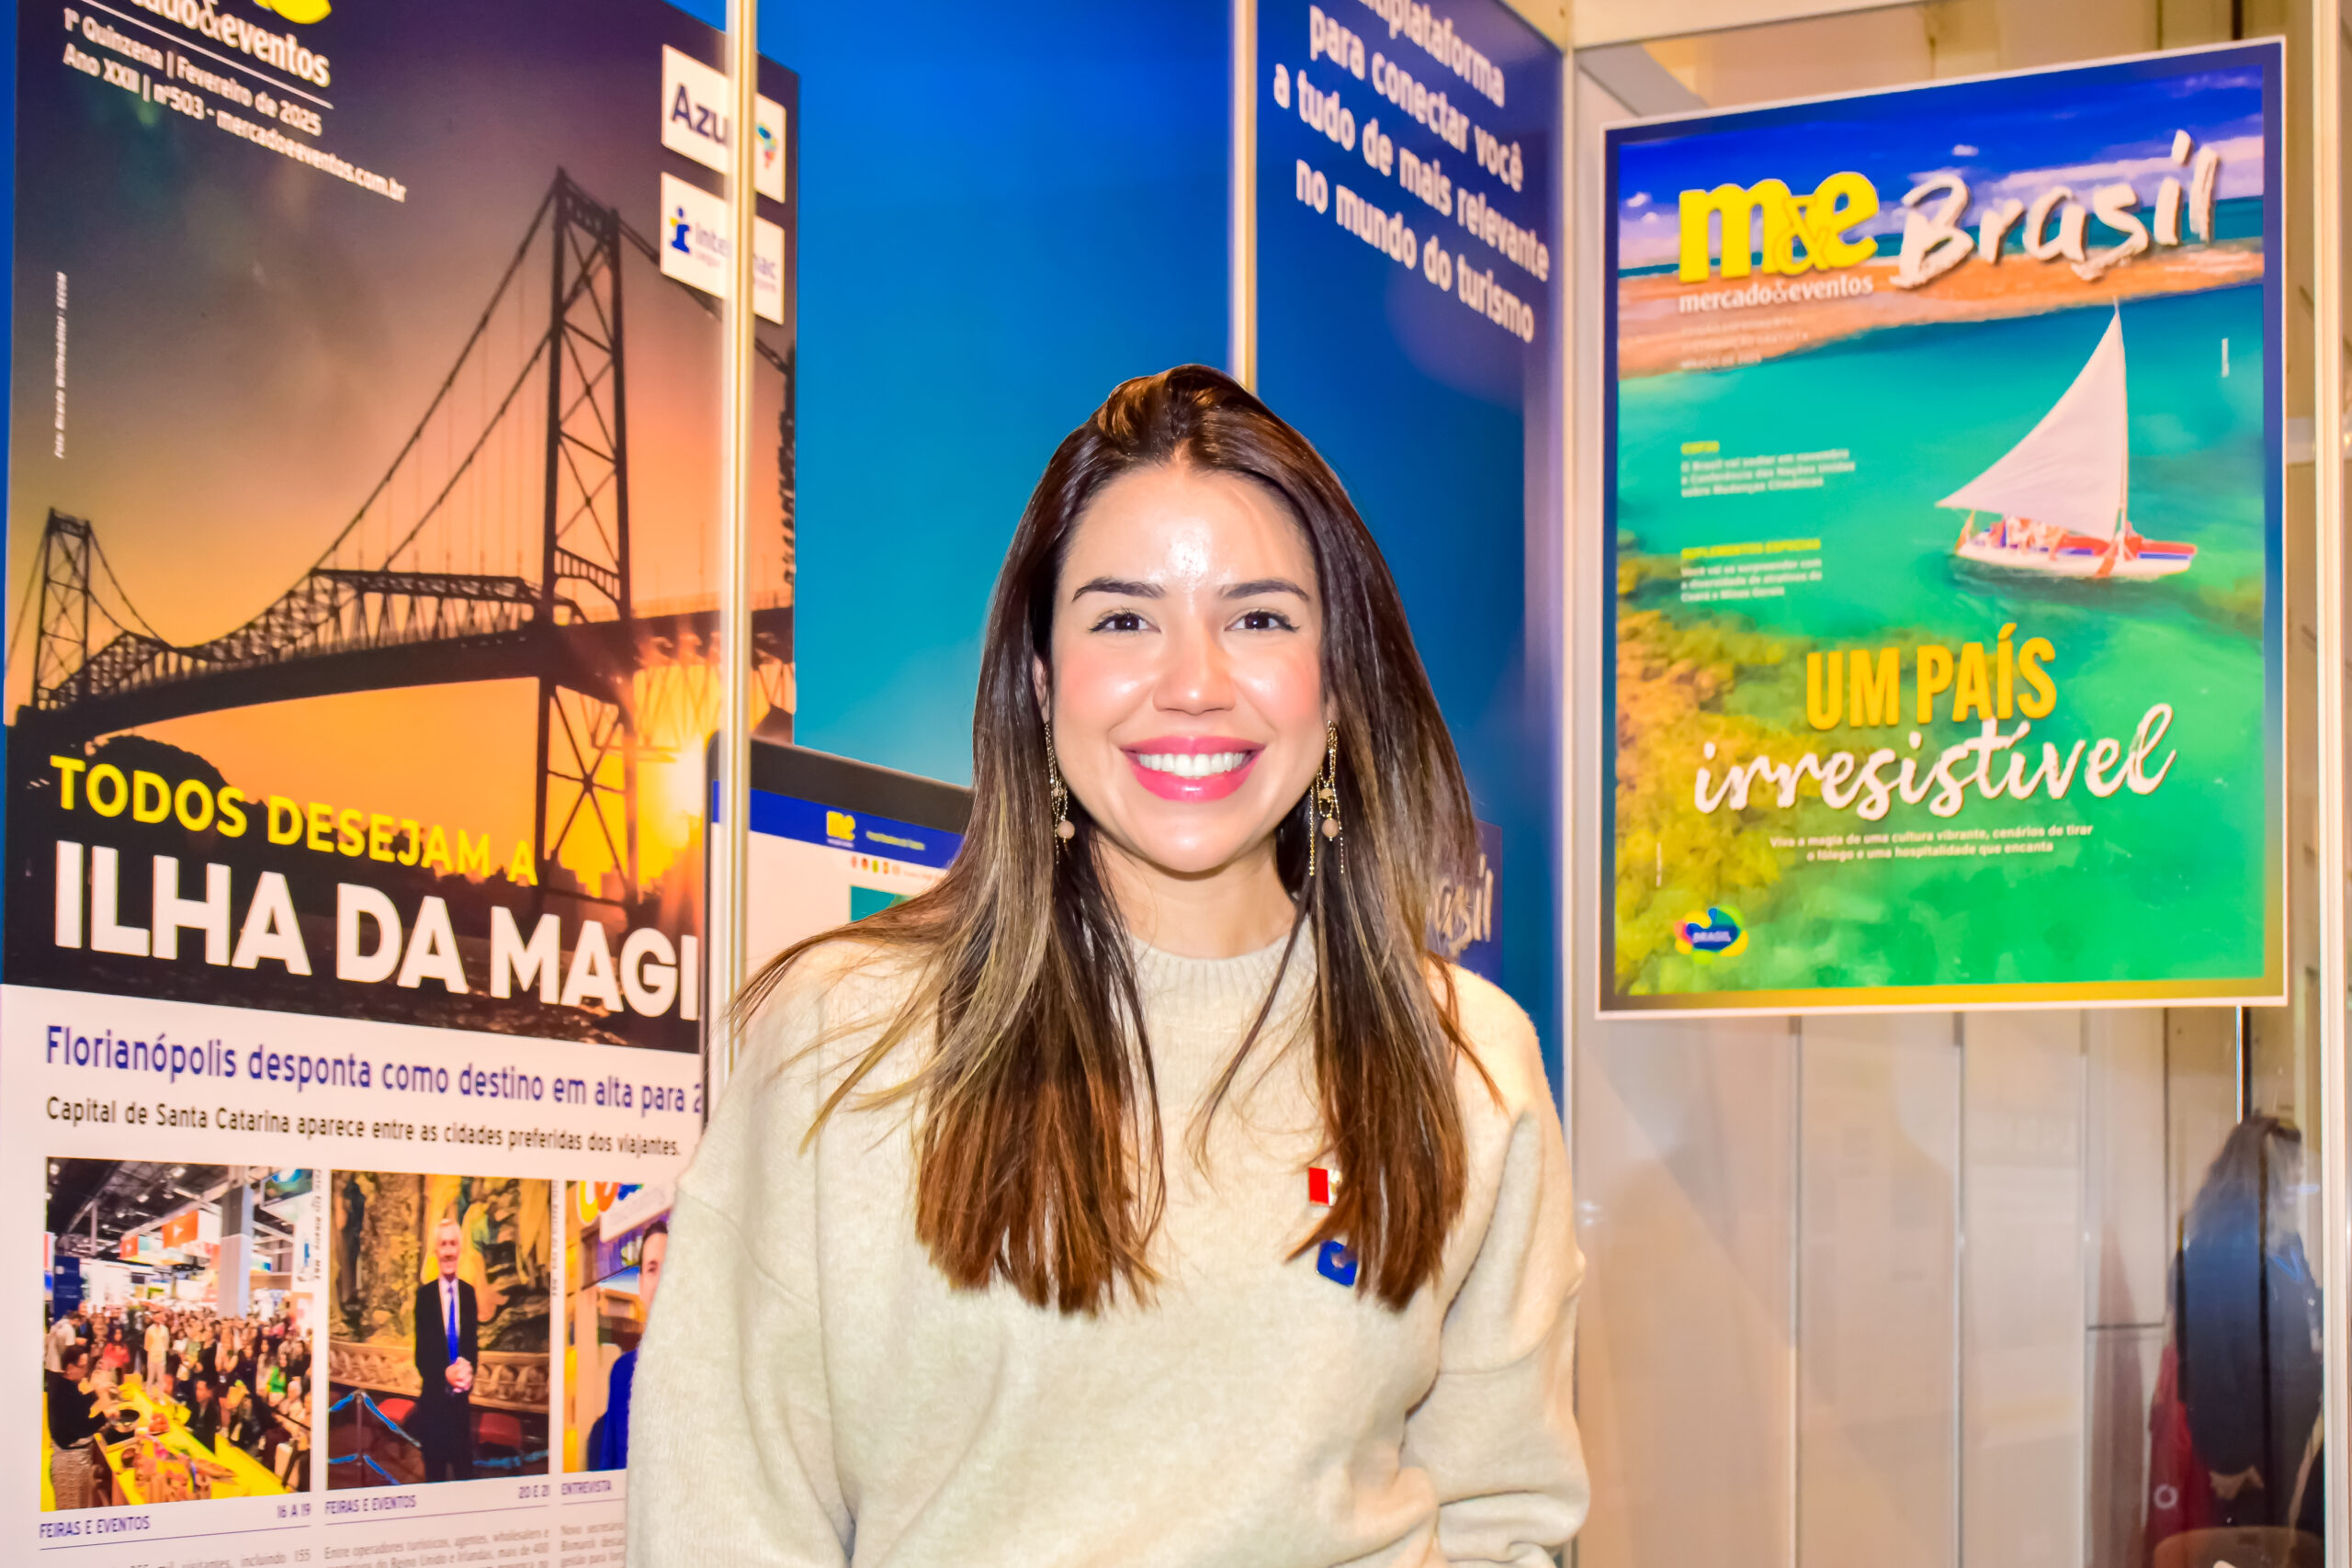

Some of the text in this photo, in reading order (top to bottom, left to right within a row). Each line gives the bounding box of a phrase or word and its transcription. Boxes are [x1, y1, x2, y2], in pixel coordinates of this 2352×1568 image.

[62, 42, 100, 77] Ano
[82, 16, 164, 70] Quinzena
[177, 55, 253, 107] Fevereiro
[254, 91, 277, 118] de
[279, 99, 322, 137] 2025
[1357, 0, 1505, 107] plataforma
[671, 82, 729, 146] Azu
[1310, 5, 1523, 193] para conectar você
[1273, 63, 1549, 282] a tudo de mais relevante
[1678, 129, 2220, 289] m&e Brasil
[1295, 159, 1534, 343] no mundo do turismo
[1679, 275, 1874, 313] mercado&eventos
[1806, 622, 2057, 729] UM PAÍS
[1694, 703, 2177, 821] irresistível
[50, 754, 539, 886] TODOS DESEJAM A
[1770, 835, 1795, 848] Viva
[1808, 834, 1843, 848] magia
[1846, 832, 1861, 845] de
[1863, 833, 1889, 844] uma
[1892, 830, 1934, 843] cultura
[1936, 829, 1990, 840] vibrante,
[1992, 825, 2045, 840] cenários
[2047, 824, 2064, 837] de
[2066, 824, 2094, 836] tirar
[1866, 849, 1892, 859] uma
[1894, 843, 1975, 859] hospitalidade
[1979, 843, 2002, 857] que
[2004, 841, 2053, 854] encanta
[54, 840, 700, 1021] ILHA DA MAGI
[46, 1025, 237, 1084] Florianópolis
[249, 1044, 371, 1092] desponta
[381, 1062, 449, 1093] como
[460, 1064, 544, 1101] destino
[553, 1077, 586, 1105] em
[595, 1076, 633, 1109] alta
[641, 1083, 684, 1118] para
[47, 1096, 680, 1157] Capital de Santa Catarina aparece entre as cidades preferidas dos viajantes.
[277, 1503, 311, 1518] 16 A 19
[324, 1495, 417, 1514] FEIRAS E EVENTOS
[533, 1484, 539, 1497] E
[561, 1480, 612, 1495] ENTREVISTA
[40, 1516, 151, 1539] FEIRAS E EVENTOS
